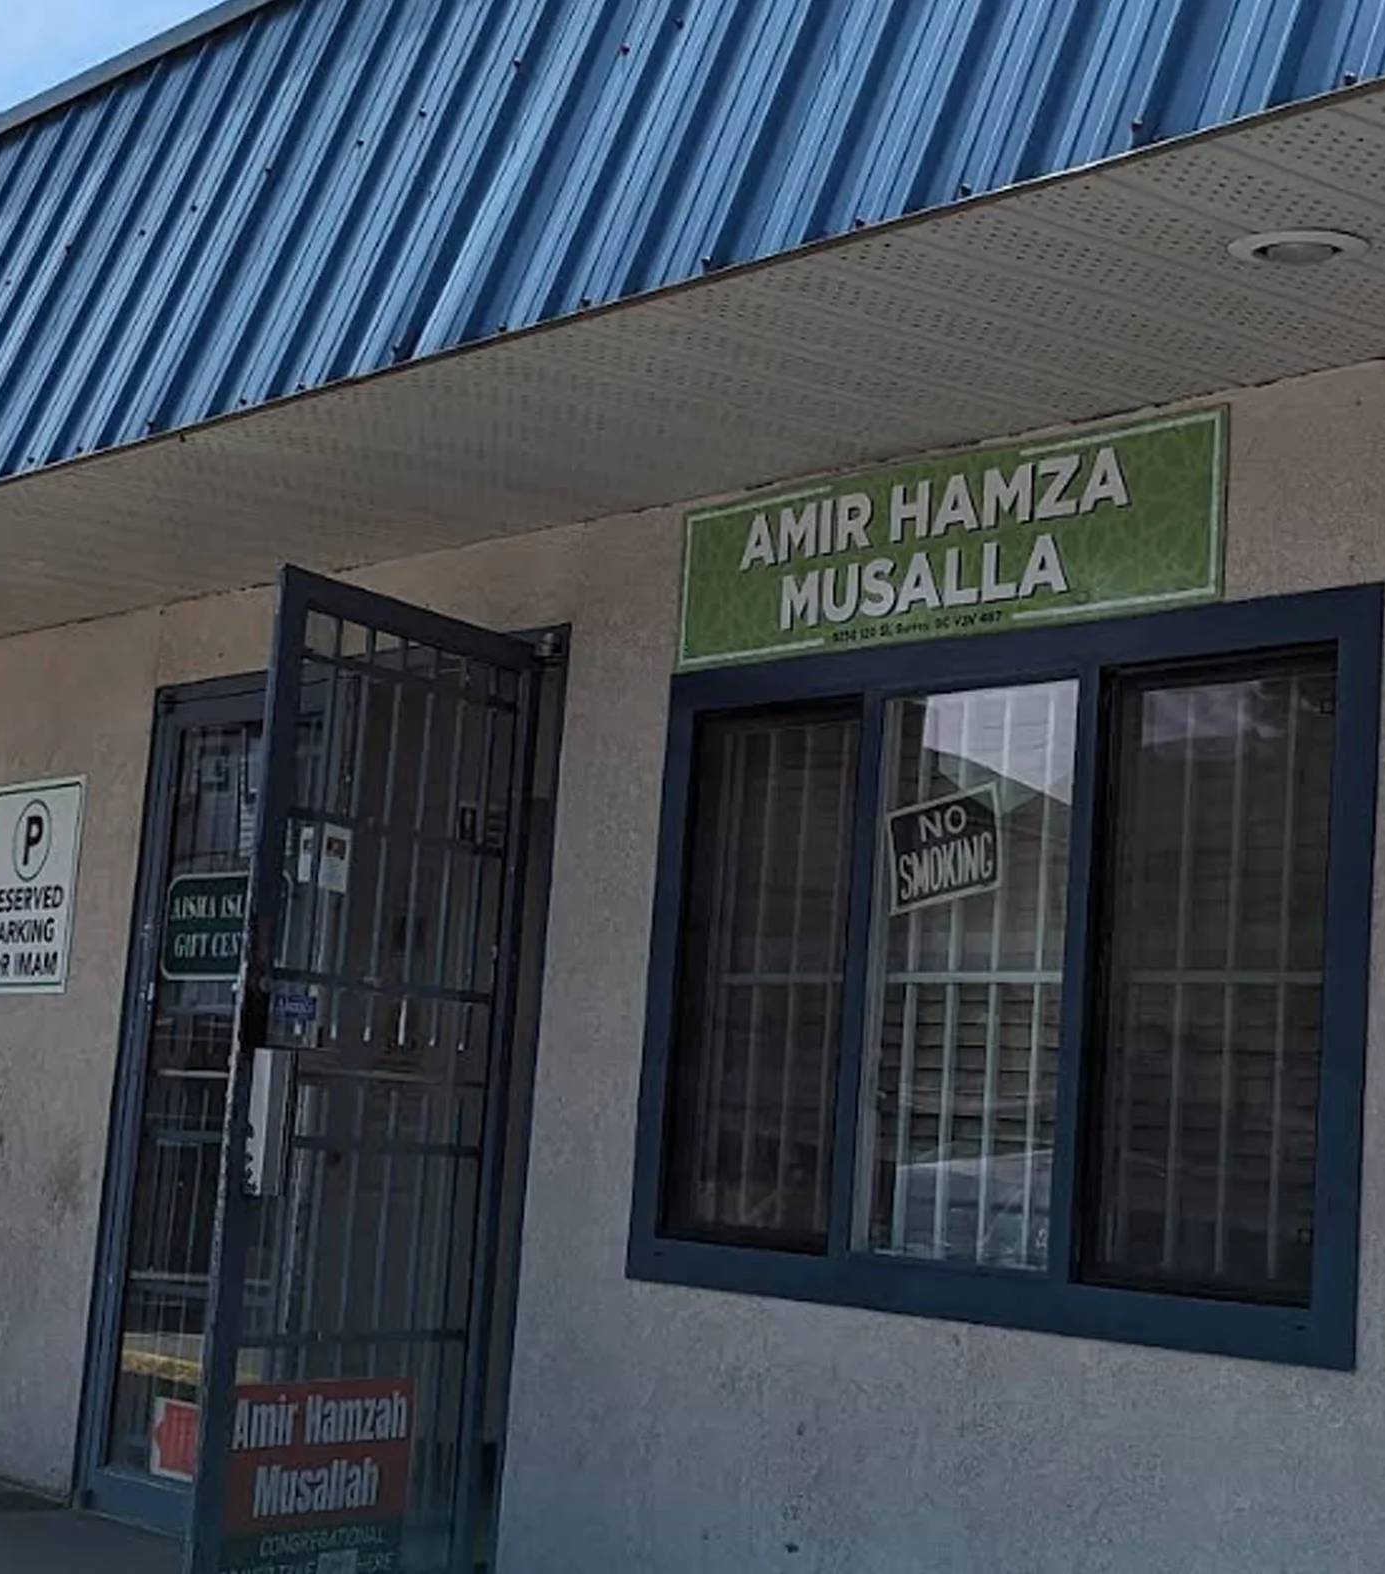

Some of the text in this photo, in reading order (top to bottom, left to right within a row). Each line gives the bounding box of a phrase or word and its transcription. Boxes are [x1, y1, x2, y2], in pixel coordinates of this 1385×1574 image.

[739, 448, 1130, 570] AMIR HAMZA
[778, 534, 1068, 631] MUSALLA
[22, 815, 44, 867] P
[918, 805, 967, 843] NO
[898, 831, 993, 901] SMOKING
[170, 895, 216, 920] AISHA
[14, 951, 58, 978] IMAM
[174, 932, 211, 958] GIFT
[232, 1389, 408, 1450] Amir Hamzah
[252, 1456, 381, 1520] Musallah
